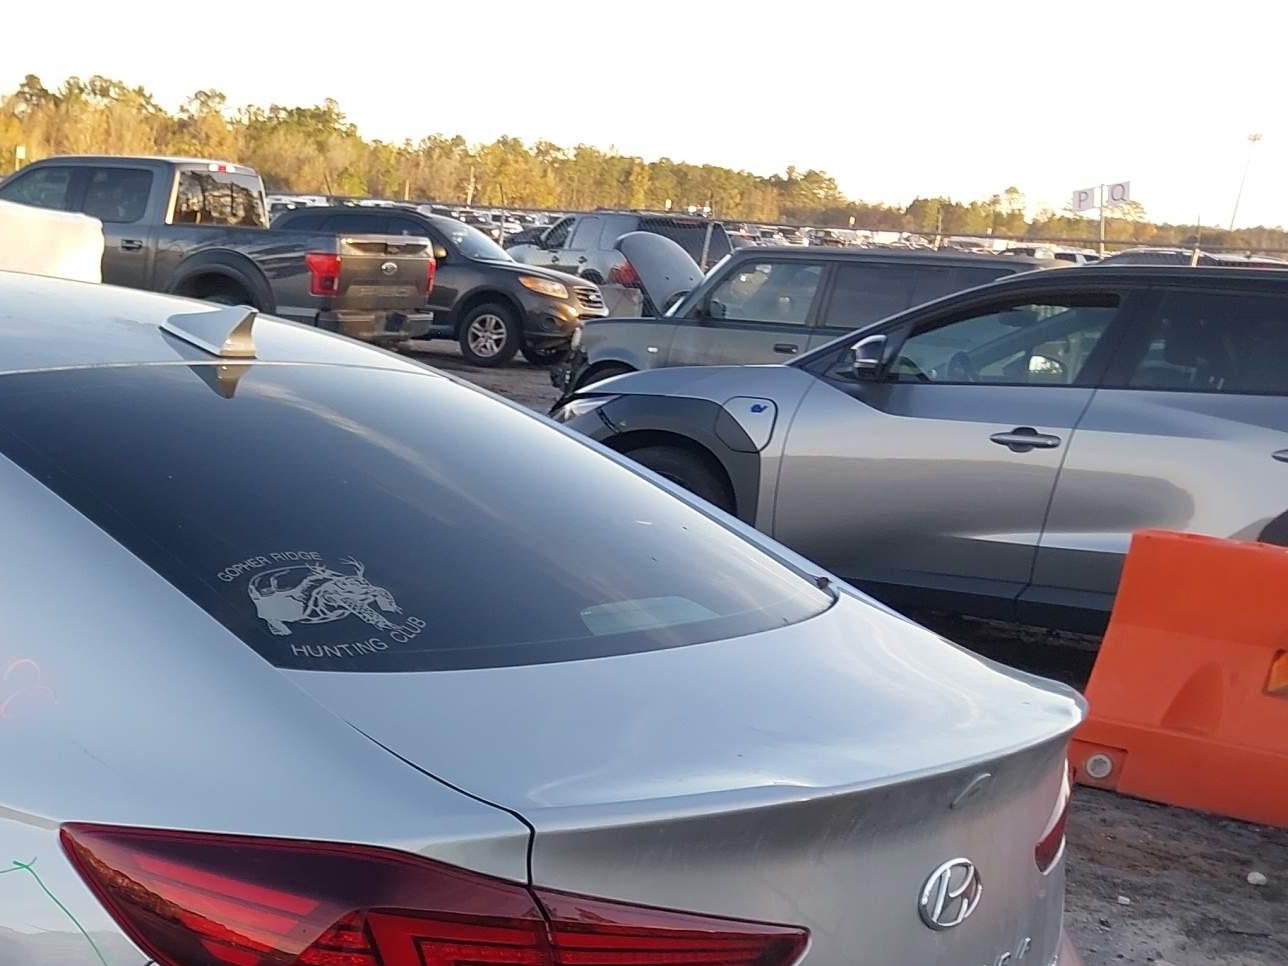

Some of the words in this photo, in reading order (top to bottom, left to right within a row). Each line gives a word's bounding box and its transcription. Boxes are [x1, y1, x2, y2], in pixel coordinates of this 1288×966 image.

[1078, 191, 1089, 209] P
[1111, 183, 1127, 202] Q
[217, 556, 272, 583] GOPHER
[270, 551, 323, 561] RIDGE
[290, 638, 389, 657] HUNTING
[390, 616, 427, 643] CLUB
